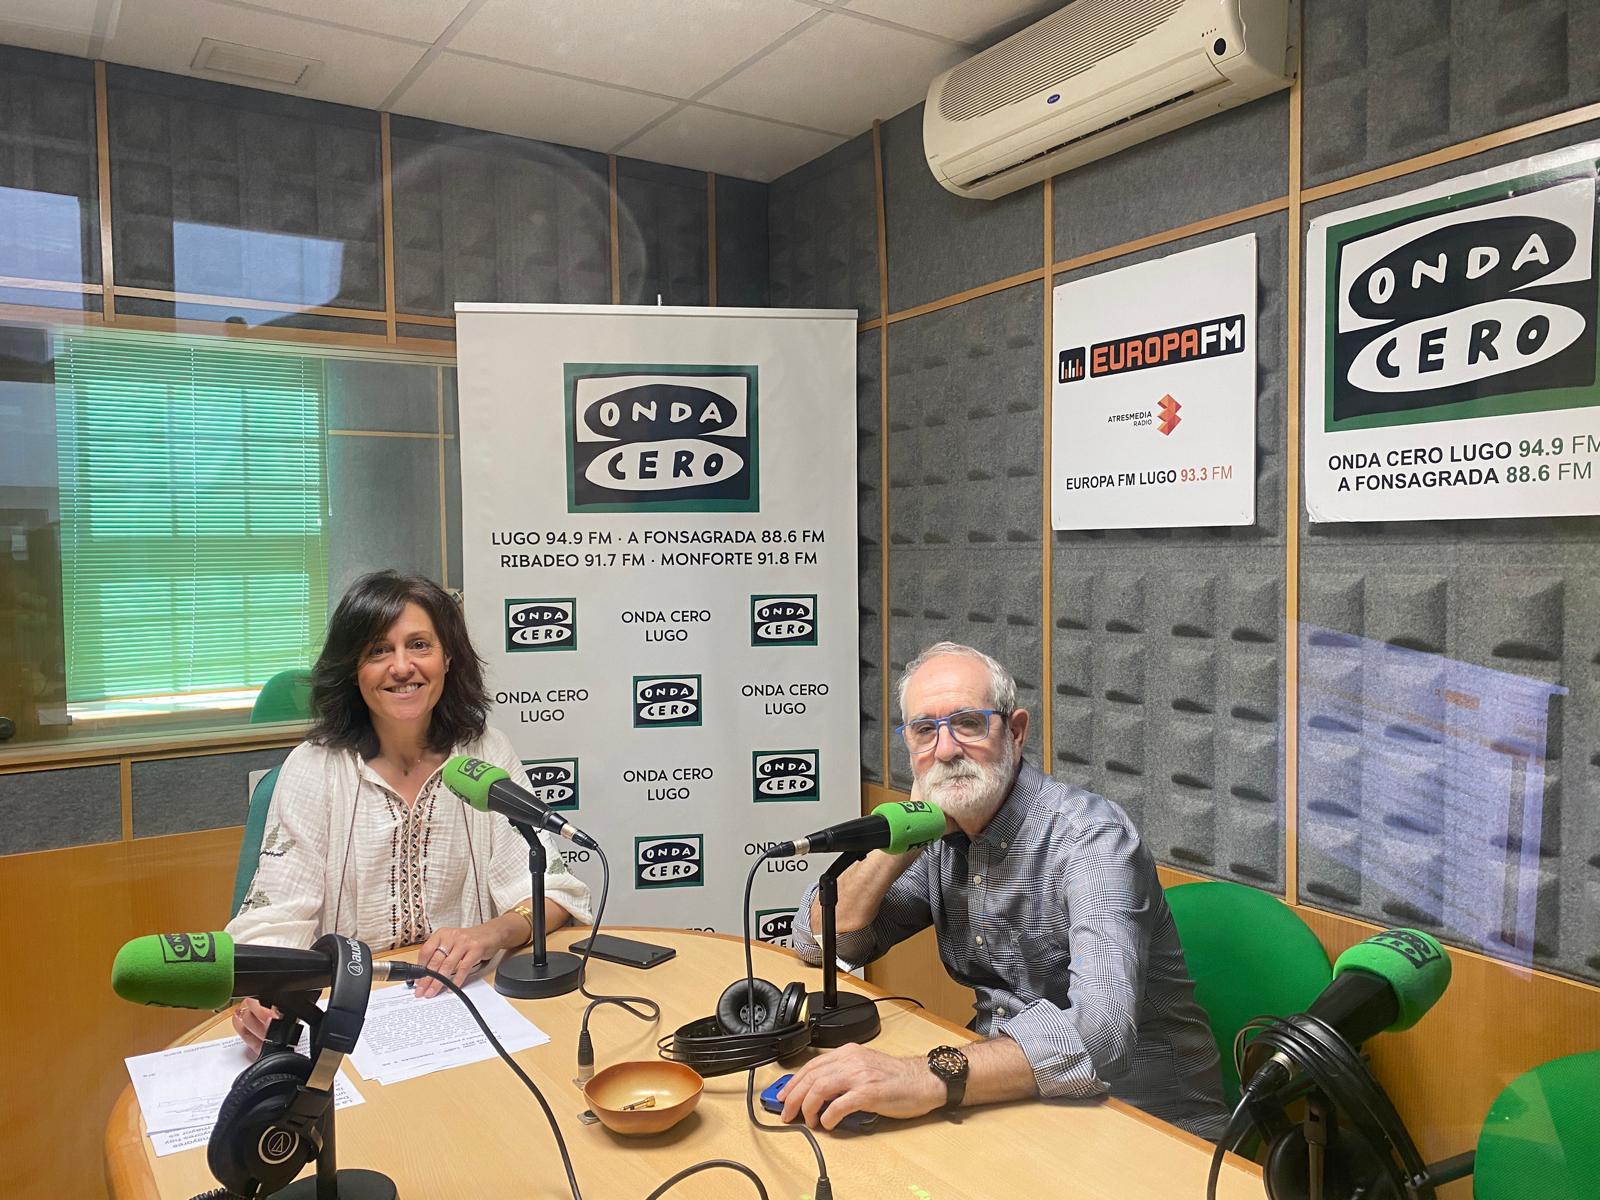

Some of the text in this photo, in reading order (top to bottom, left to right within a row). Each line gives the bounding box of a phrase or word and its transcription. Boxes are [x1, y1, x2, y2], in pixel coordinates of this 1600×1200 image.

[1367, 233, 1549, 304] ONDA
[1093, 320, 1241, 374] EUROPAFM
[1376, 315, 1550, 379] CERO
[599, 401, 722, 426] ONDA
[1108, 411, 1152, 423] ATRESMEDIA
[1328, 434, 1600, 470] ONDA CERO LUGO 94.9 FM
[607, 450, 724, 480] CERO
[1066, 465, 1233, 490] EUROPA FM LUGO 93.3 FM
[1337, 461, 1591, 492] A FONSAGRADA 88.6 FM
[491, 529, 825, 546] LUGO 94.9 FM A FONSAGRADA 88.6 FM
[500, 551, 818, 568] RIBADEO 91.7 FM MONFORTE 91.8 FM
[517, 610, 564, 622] ONDA
[621, 609, 712, 624] ONDA CERO
[762, 606, 806, 617] ONDA
[520, 628, 564, 640] CERO
[645, 629, 688, 642] LUGO
[765, 623, 806, 636] CERO
[495, 688, 589, 705] ONDA CERO
[644, 685, 690, 699] ONDA
[741, 683, 829, 697] ONDA CERO
[520, 709, 565, 723] LUGO
[647, 704, 689, 717] CERO
[765, 702, 806, 716] LUGO
[764, 761, 808, 773] ONDA
[531, 770, 566, 781] NDA
[623, 767, 713, 783] ONDA CERO
[766, 778, 808, 791] CERO
[535, 789, 566, 800] ERO
[647, 787, 690, 801] LUGO
[560, 850, 590, 864] ERO
[646, 845, 691, 860] ONDA
[649, 864, 691, 878] CERO
[767, 859, 809, 873] LUGO
[766, 920, 794, 933] ON
